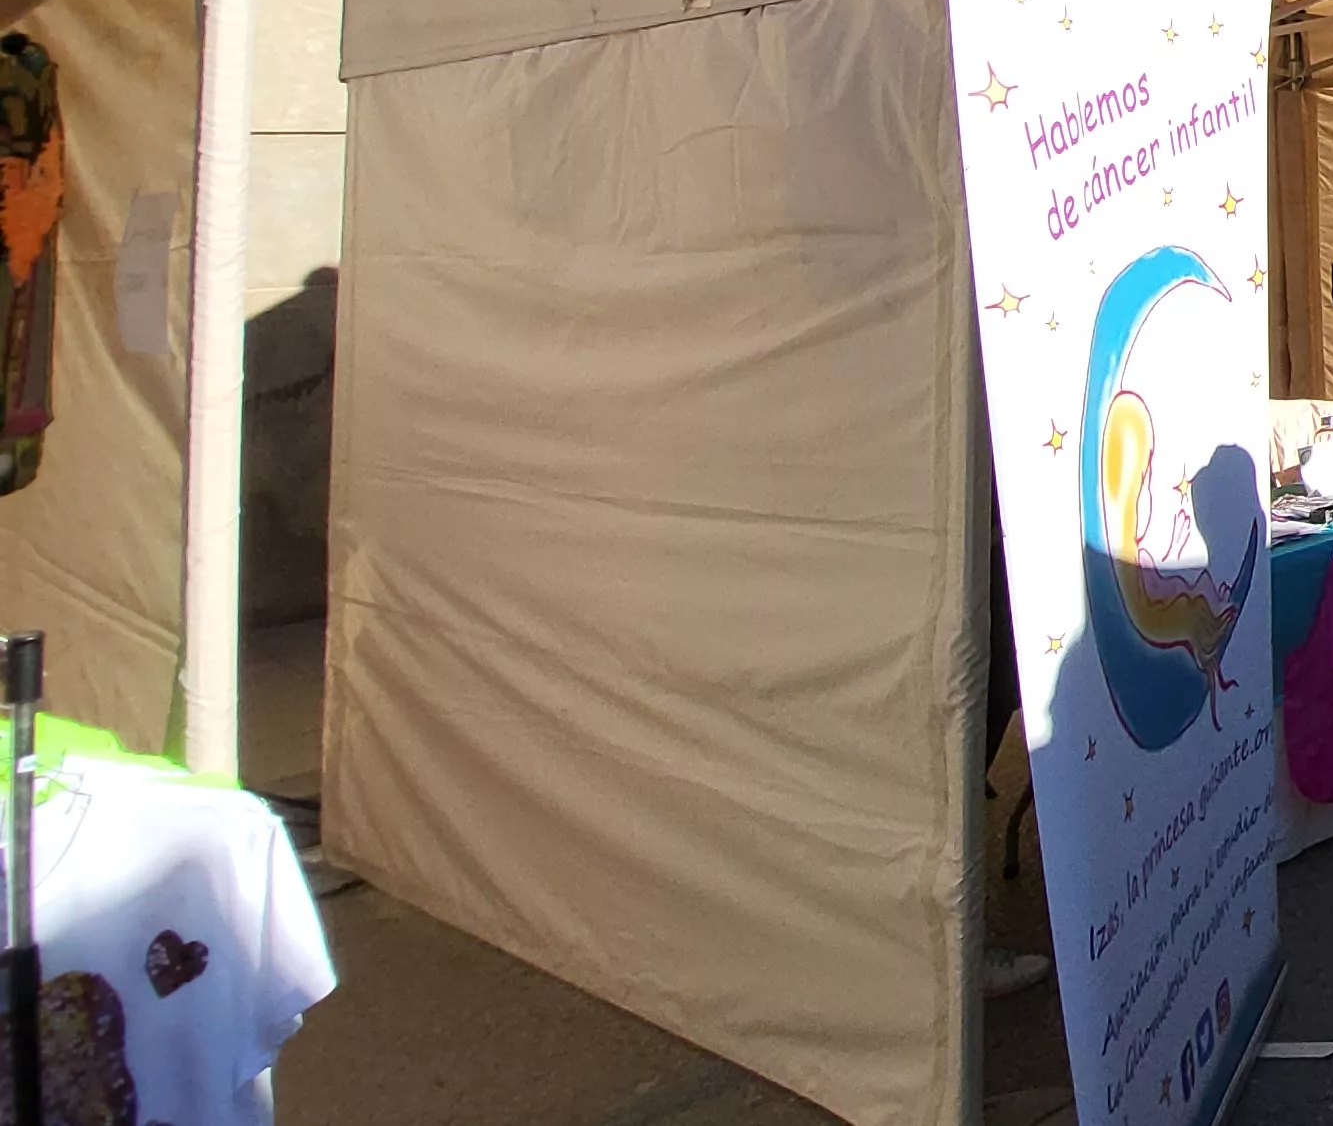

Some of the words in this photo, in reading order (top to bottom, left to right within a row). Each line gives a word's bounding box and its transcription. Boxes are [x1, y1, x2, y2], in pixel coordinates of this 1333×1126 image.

[1024, 73, 1150, 169] Hablemos
[1047, 189, 1079, 240] de
[1084, 156, 1160, 212] cáncer
[1169, 78, 1256, 157] infantil
[1127, 870, 1140, 909] la
[1143, 801, 1195, 899] princesa
